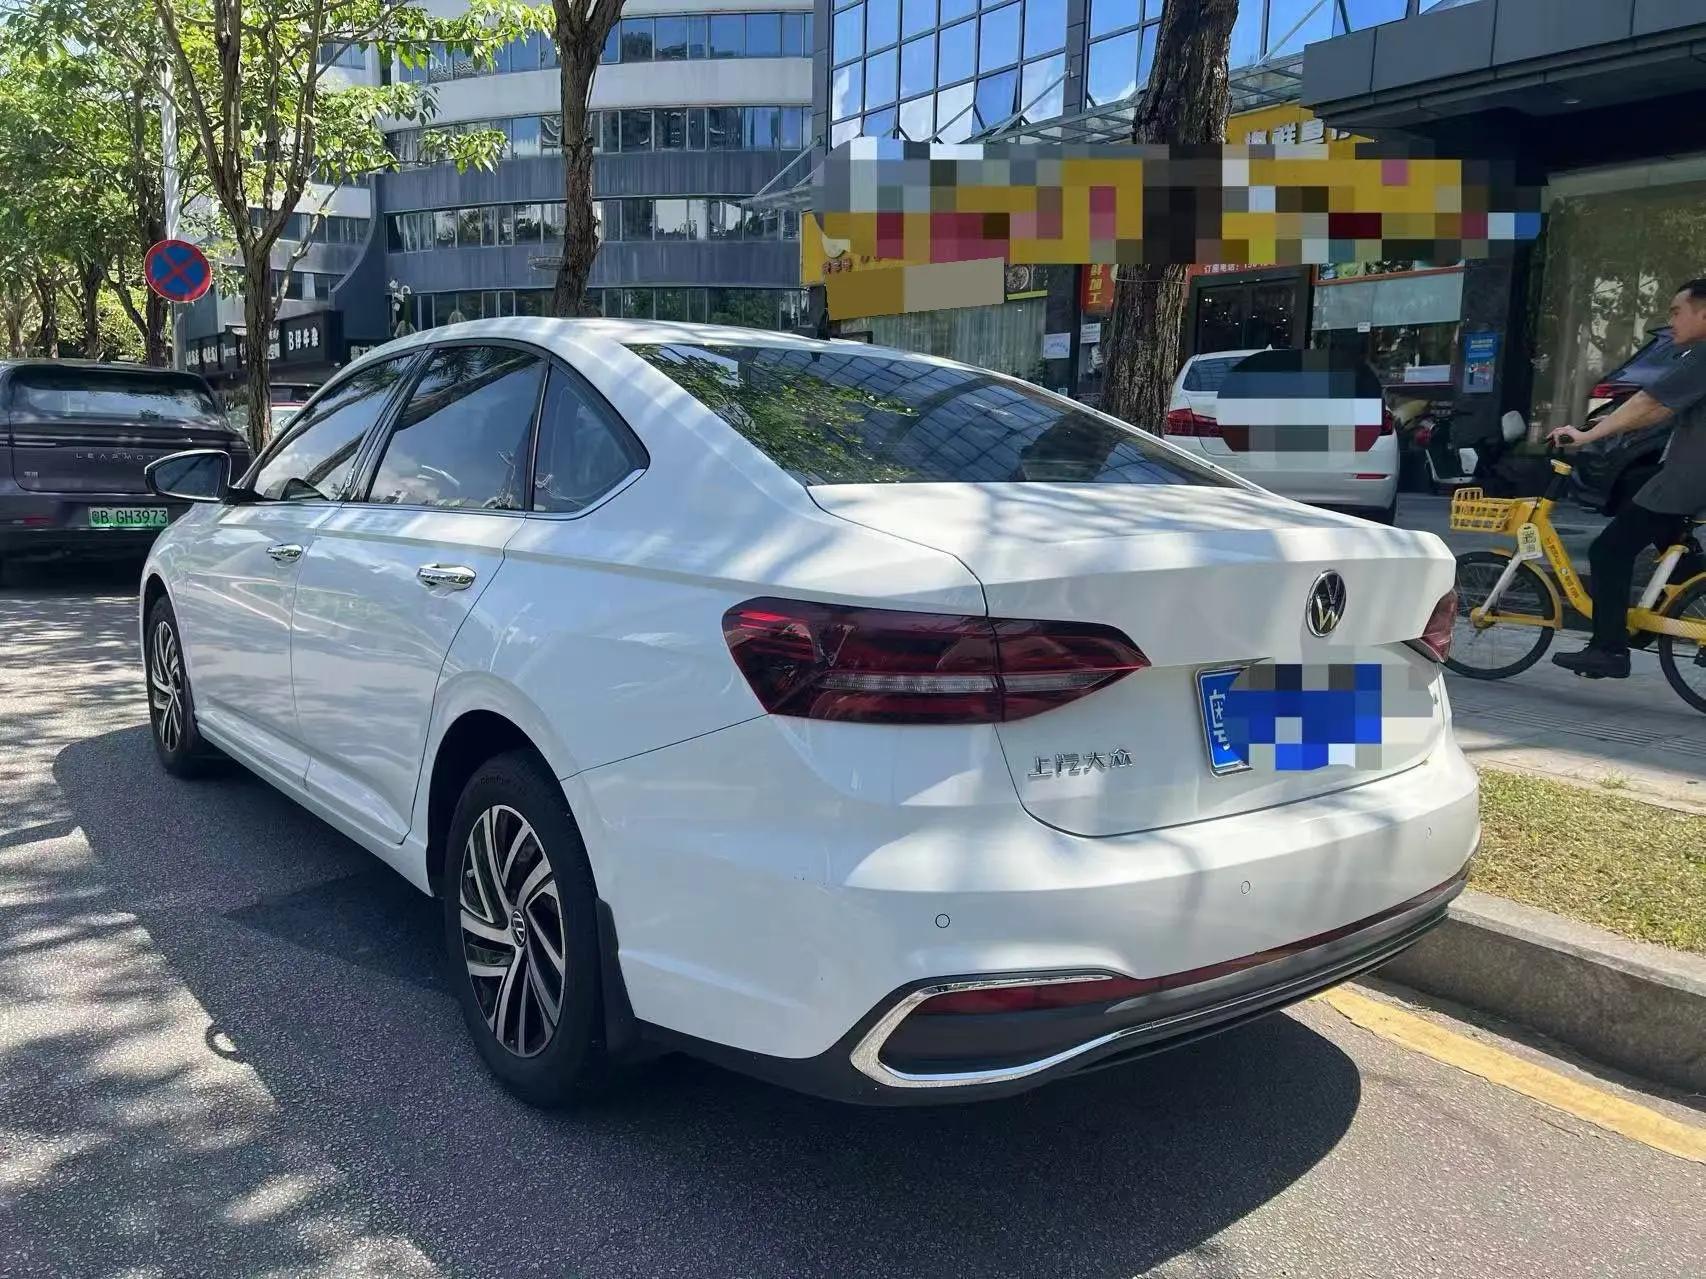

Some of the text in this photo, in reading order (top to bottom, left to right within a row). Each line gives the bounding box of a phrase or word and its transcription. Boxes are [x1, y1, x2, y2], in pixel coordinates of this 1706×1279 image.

[115, 510, 167, 525] GH3973
[1027, 748, 1134, 776] 上汽大众
